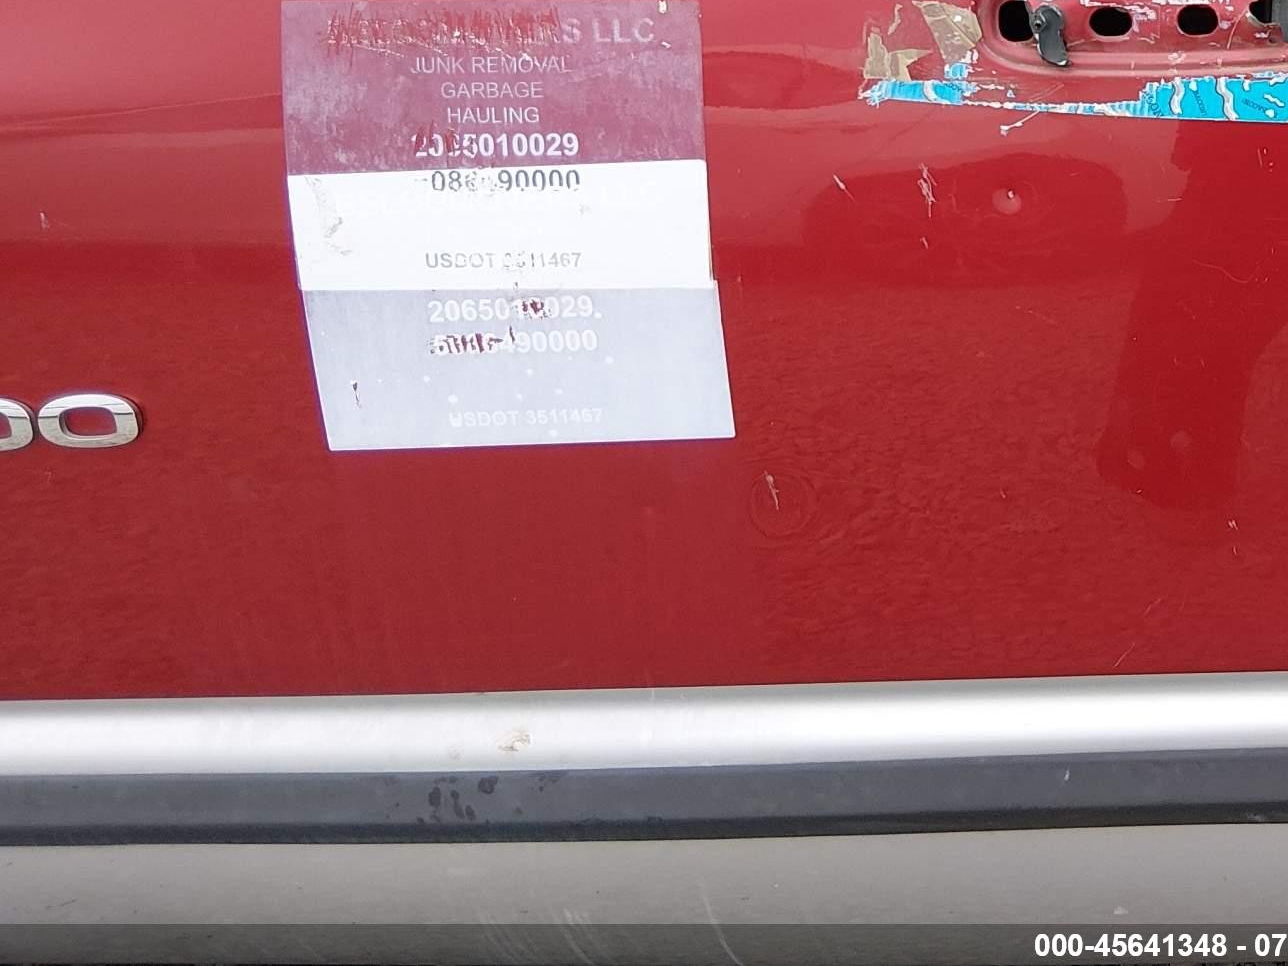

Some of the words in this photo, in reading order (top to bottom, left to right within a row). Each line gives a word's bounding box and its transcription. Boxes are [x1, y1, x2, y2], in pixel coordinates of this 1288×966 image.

[593, 18, 655, 43] LLC
[410, 56, 465, 75] JUNK
[471, 55, 574, 74] REMOVAL
[440, 81, 544, 99] GARBAGE
[447, 107, 540, 124] HAULING
[424, 251, 496, 269] USDOT
[448, 410, 519, 428] USDOT
